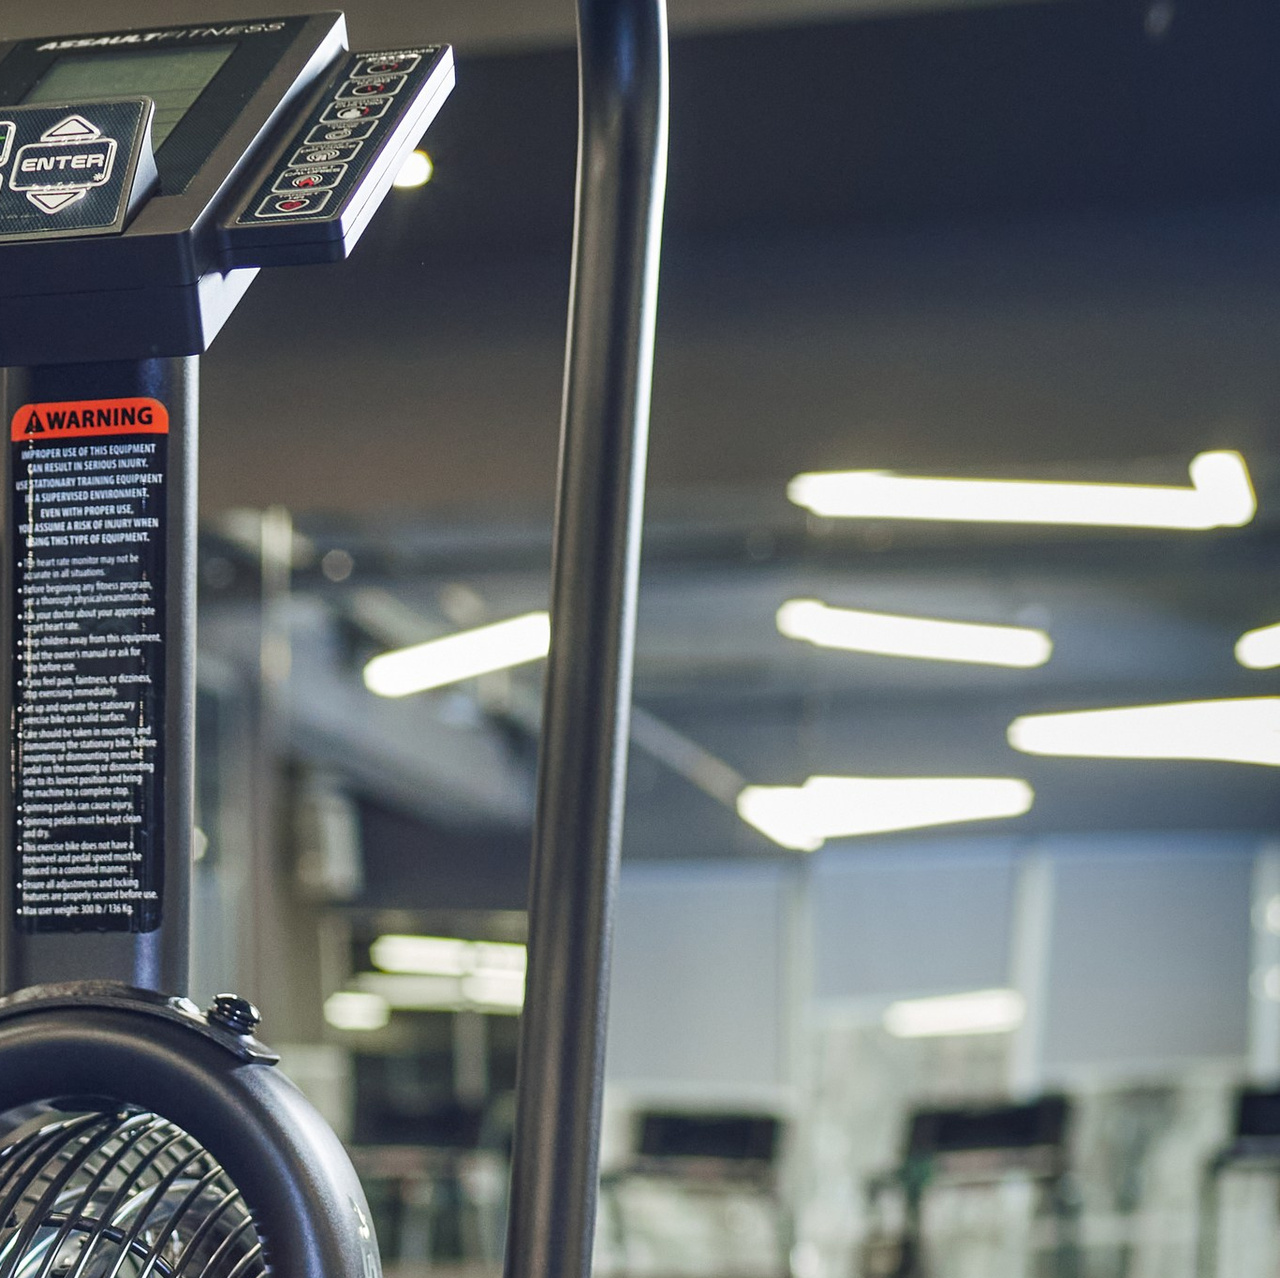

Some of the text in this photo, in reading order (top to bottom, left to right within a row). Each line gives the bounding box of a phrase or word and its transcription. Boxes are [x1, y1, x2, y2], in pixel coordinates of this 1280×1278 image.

[21, 153, 105, 172] ENTER
[46, 406, 154, 430] WARNING
[22, 444, 156, 459] IMPROPER USE OF THIS EQUIPMENT
[45, 462, 72, 472] RESULT
[84, 460, 117, 470] SERIOUS
[118, 458, 148, 468] INJURY.
[16, 481, 28, 490] USE
[78, 476, 114, 487] TRAINING
[116, 474, 162, 485] EQUIPMENT
[42, 491, 88, 502] SUPERVISED
[90, 488, 149, 500] ENVIRONMENT.
[41, 505, 134, 518] EVEN WITH PROPER USE.
[35, 523, 65, 533] ASSUME
[74, 522, 91, 531] RISK
[93, 521, 102, 530] OF
[105, 520, 132, 529] INJURY
[134, 518, 158, 528] WHEN
[51, 536, 68, 546] THIS
[70, 535, 89, 545] TYPE
[90, 535, 100, 544] OF
[102, 533, 149, 543] EQUIPMENT.
